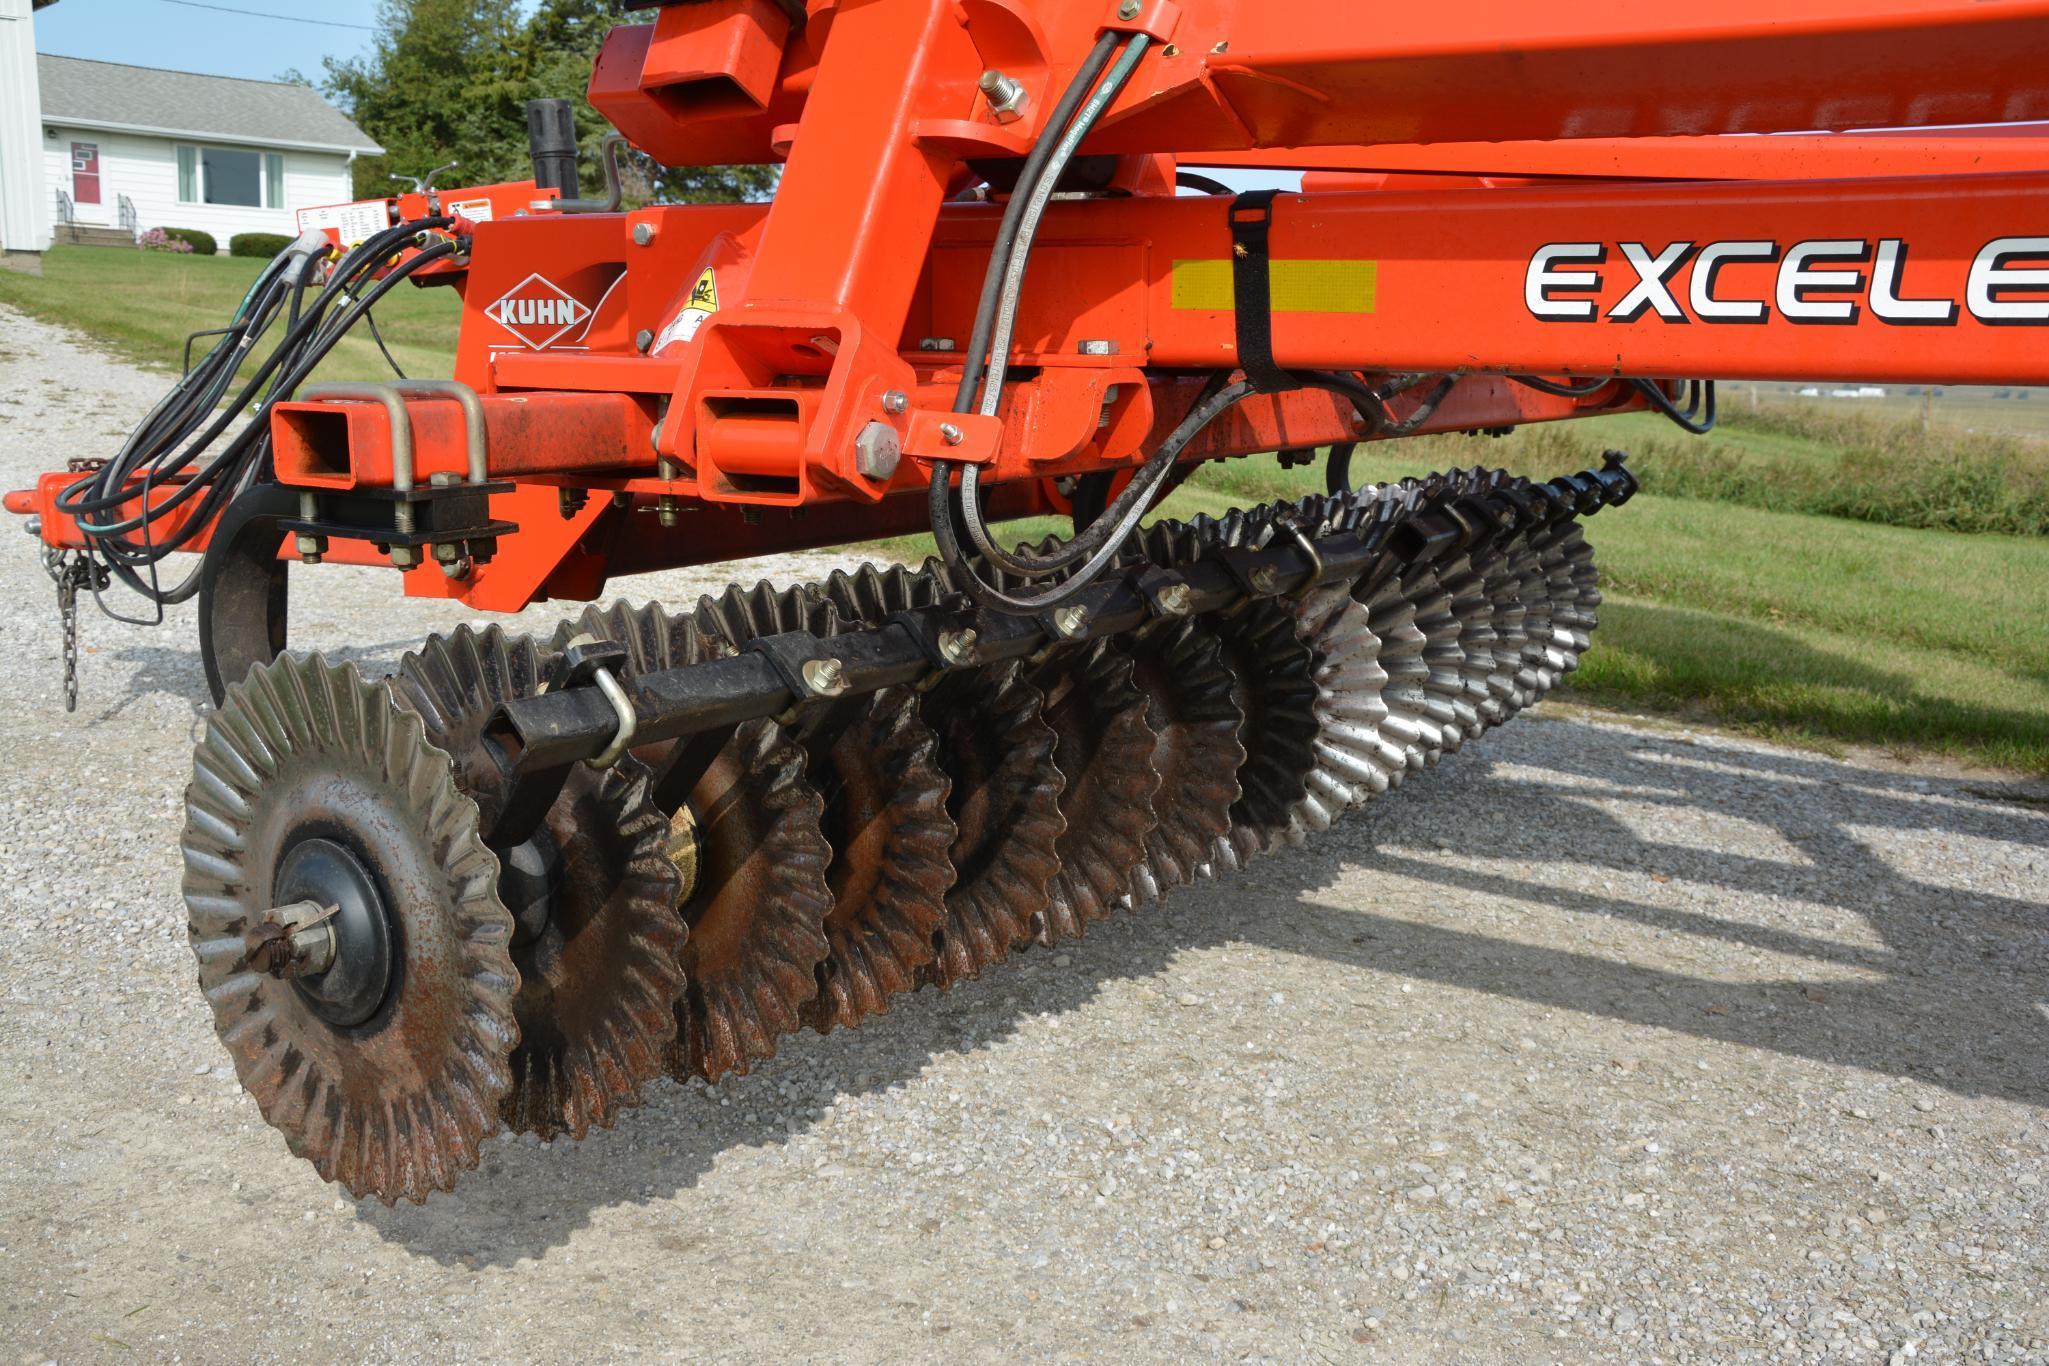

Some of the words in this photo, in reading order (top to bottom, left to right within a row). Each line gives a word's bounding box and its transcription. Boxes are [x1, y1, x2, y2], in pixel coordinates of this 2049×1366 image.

[1524, 236, 2049, 326] EXCELE
[500, 299, 575, 326] KUHN
[964, 476, 973, 493] SAE
